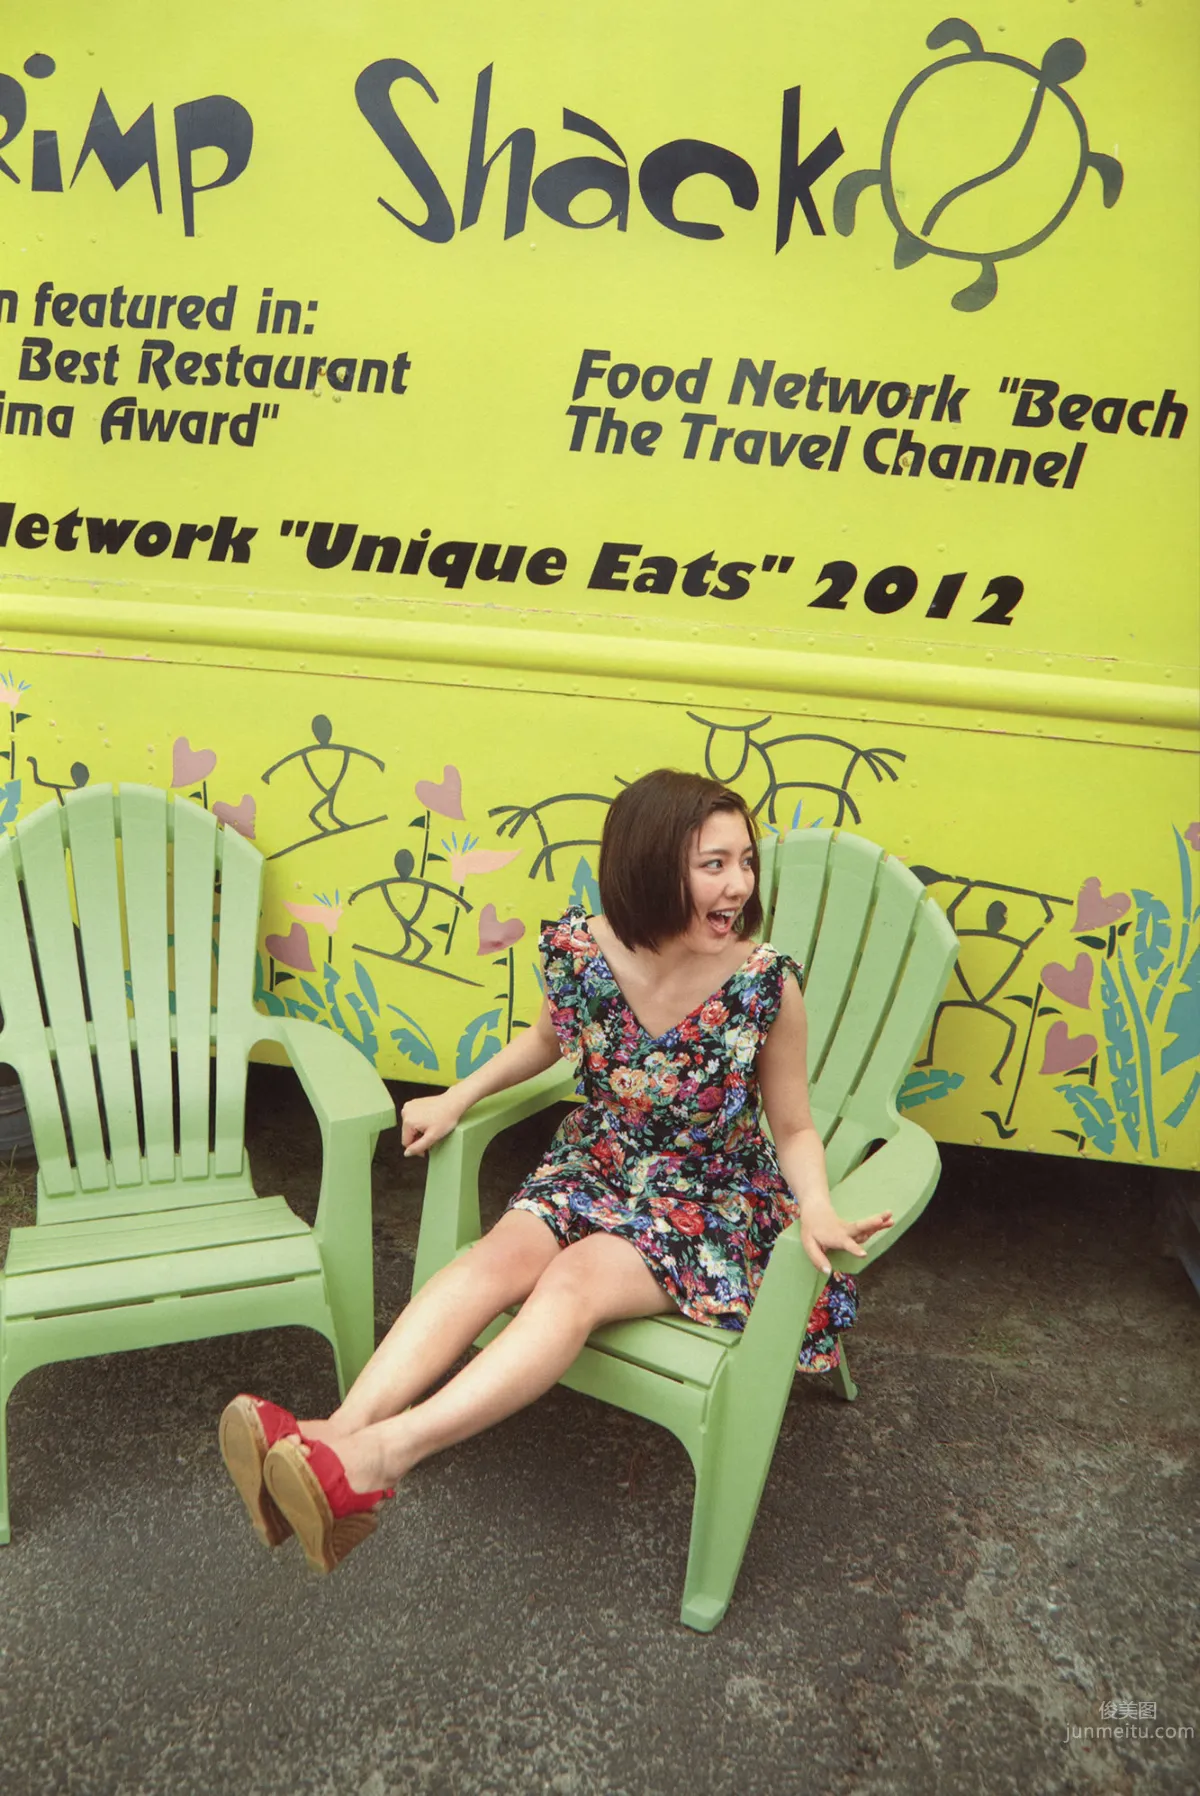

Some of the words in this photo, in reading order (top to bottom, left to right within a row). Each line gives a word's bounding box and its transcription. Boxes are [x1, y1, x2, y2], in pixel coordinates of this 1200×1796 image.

[355, 58, 845, 255] Shack
[34, 282, 237, 331] featured
[257, 287, 318, 334] in:
[19, 337, 119, 386] Best
[138, 339, 411, 394] Restaurant
[572, 349, 713, 404] Food
[728, 358, 970, 423] Network
[999, 377, 1188, 439] "Beach
[101, 397, 279, 447] Award"
[565, 405, 663, 457] The
[681, 412, 851, 472] Travel
[863, 428, 1087, 489] Channel
[280, 519, 567, 589] "Unique
[587, 542, 794, 600] Eats"
[808, 561, 1024, 625] 2012
